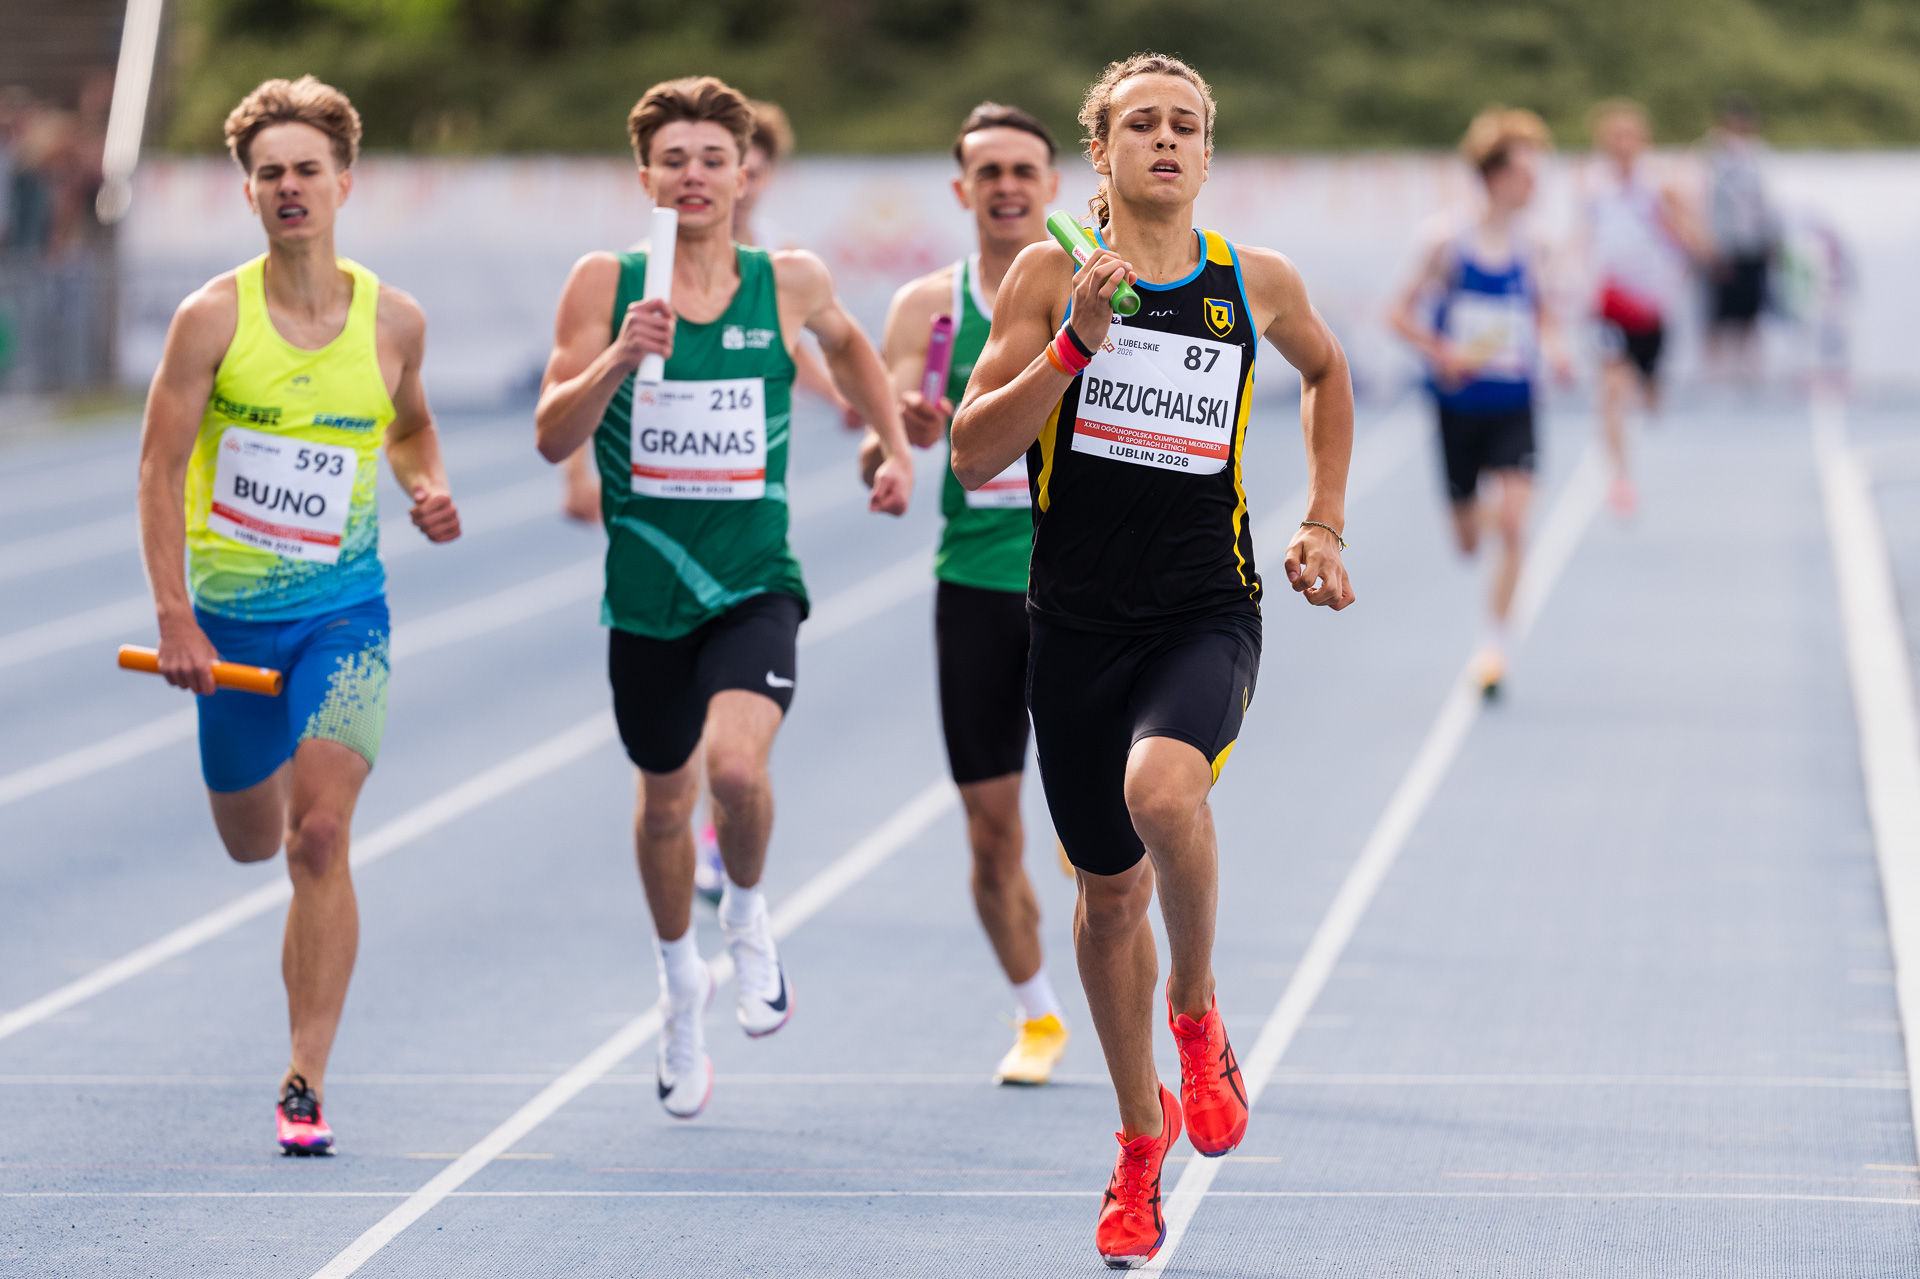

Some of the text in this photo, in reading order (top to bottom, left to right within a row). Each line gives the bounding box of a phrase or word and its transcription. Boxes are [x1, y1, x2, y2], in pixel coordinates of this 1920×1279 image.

[1117, 347, 1133, 356] 2026
[1118, 338, 1160, 352] LUBELSKIE
[1184, 345, 1220, 373] 87
[709, 387, 753, 411] 216
[1084, 376, 1229, 429] BRZUCHALSKI
[640, 428, 756, 455] GRANAS
[1084, 421, 1222, 451] XXXII OGÓLNOPOLSKA OLIMPIADA MŁODZIEŻY
[1125, 436, 1160, 448] SPORTACH
[1161, 443, 1187, 452] LETNICH
[294, 448, 345, 476] 593
[1109, 445, 1189, 467] LUBLIN 2026
[234, 475, 326, 518] BUJNO
